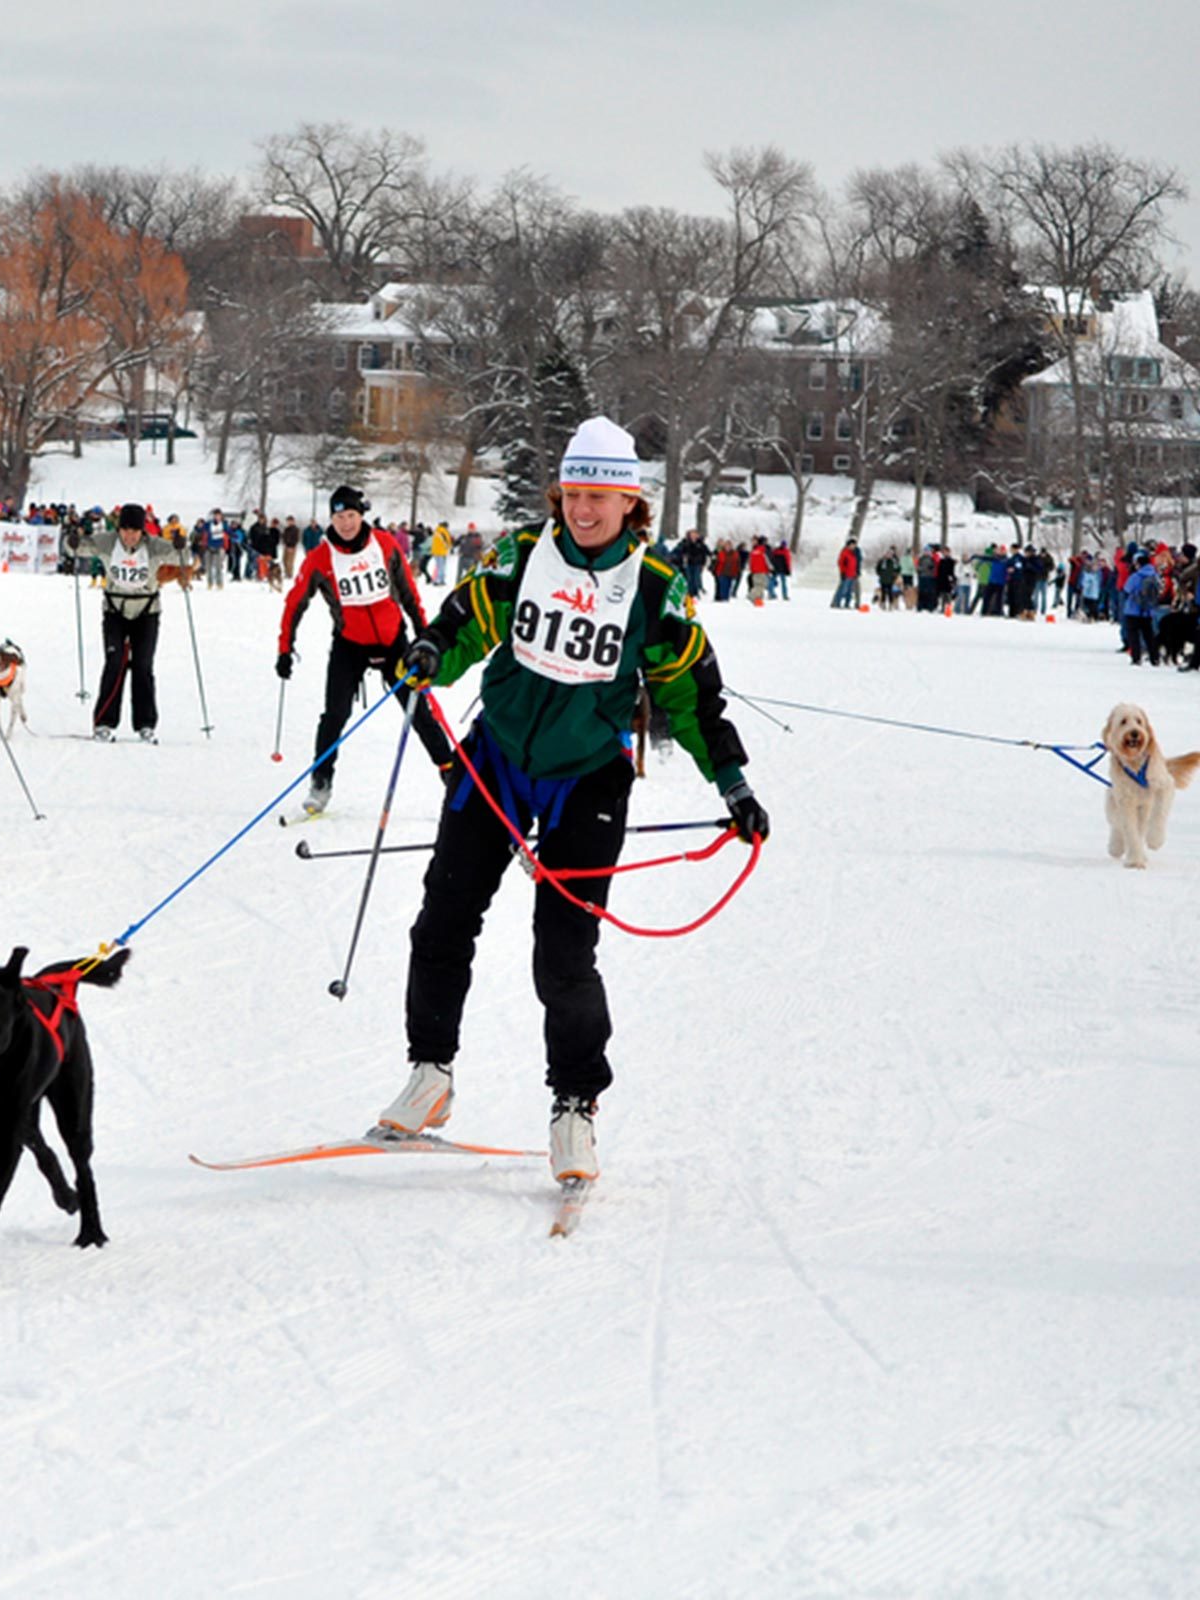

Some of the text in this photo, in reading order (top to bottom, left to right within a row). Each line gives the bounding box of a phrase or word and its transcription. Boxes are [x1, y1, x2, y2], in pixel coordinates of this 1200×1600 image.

[338, 567, 389, 596] 9113
[607, 584, 626, 604] 3
[514, 599, 624, 668] 9136
